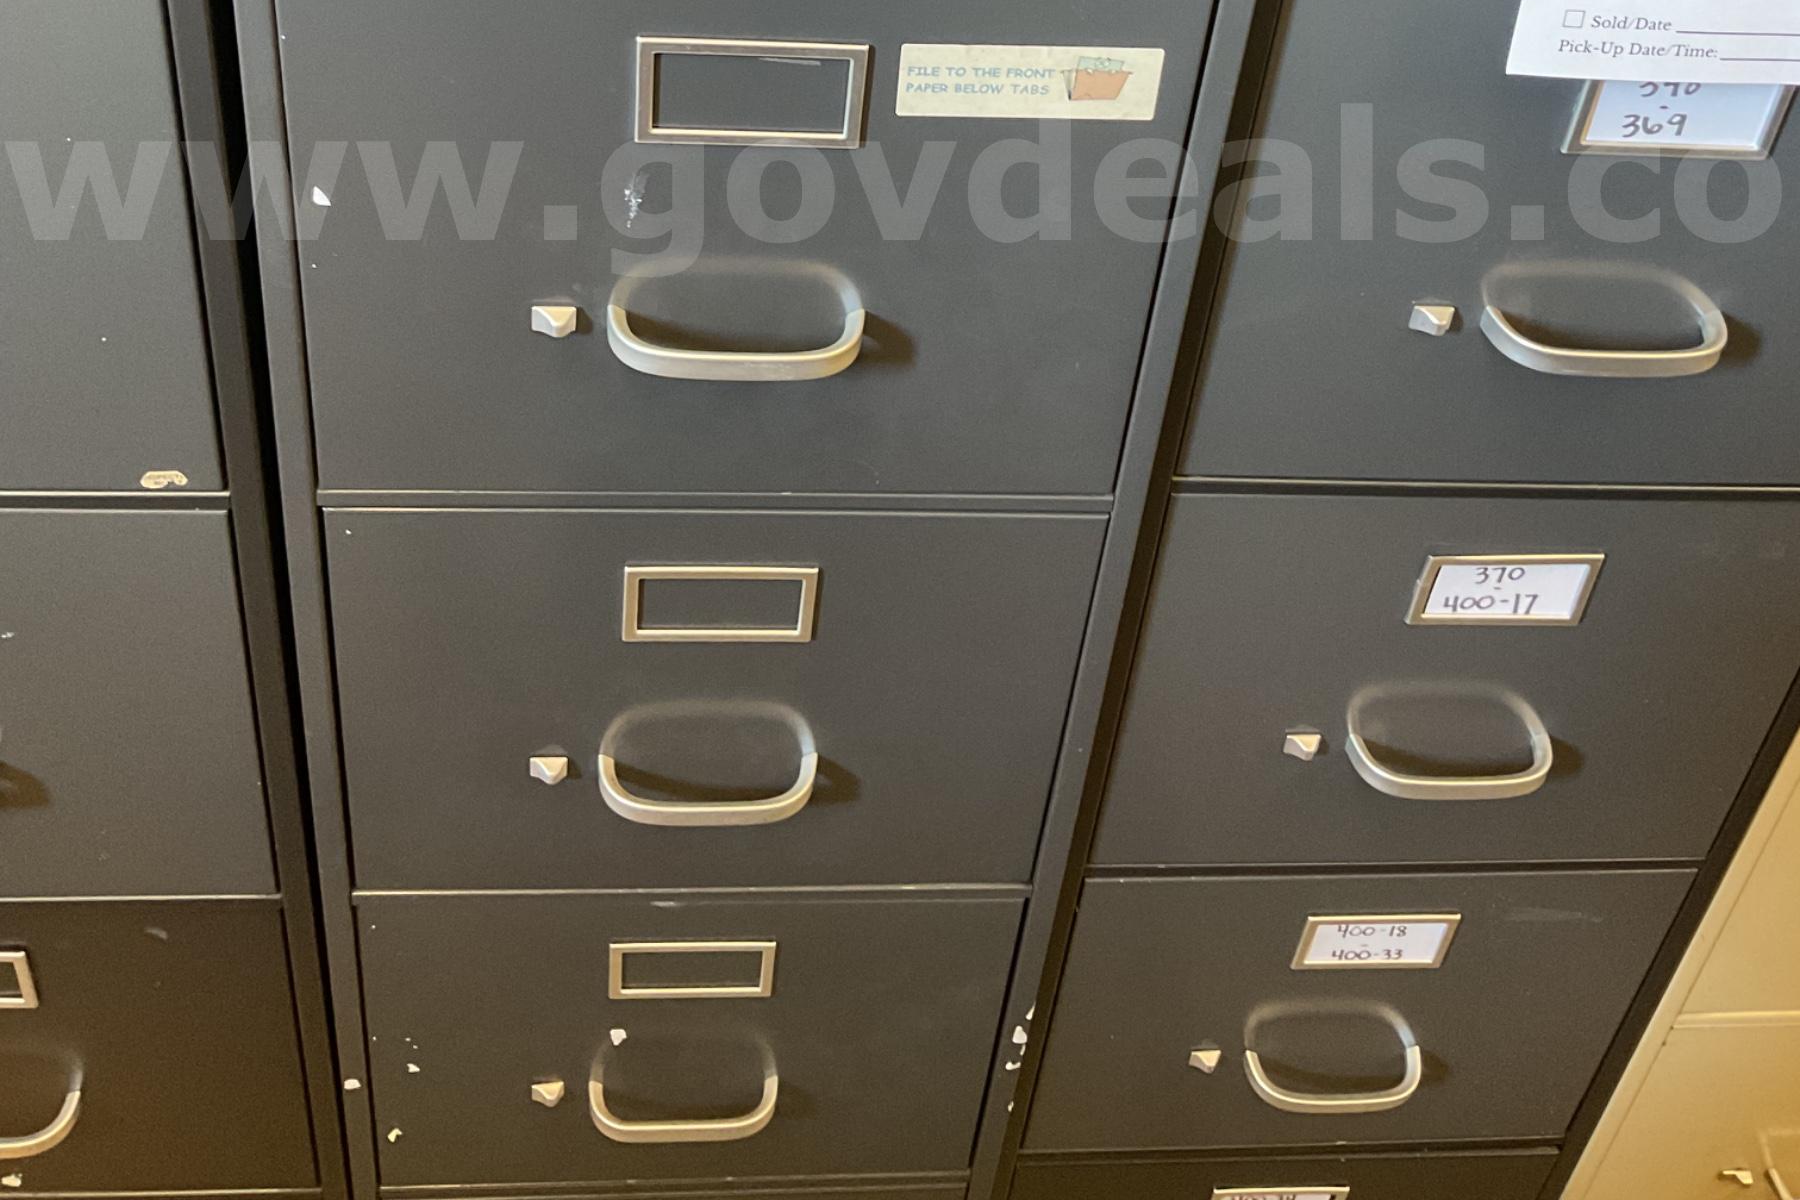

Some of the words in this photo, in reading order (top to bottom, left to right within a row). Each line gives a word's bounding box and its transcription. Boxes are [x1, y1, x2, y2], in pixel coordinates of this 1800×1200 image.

[1591, 15, 1672, 31] Sold/Date
[1558, 39, 1624, 58] Pick-Up
[1628, 42, 1718, 58] Date/Time:
[906, 66, 940, 77] FILE
[946, 66, 966, 77] TO
[972, 67, 1001, 78] THE
[1006, 68, 1056, 80] FRONT
[905, 83, 948, 94] PAPER
[954, 83, 1004, 95] BELOW
[1009, 84, 1050, 95] TABS
[1622, 113, 1688, 138] 369
[1474, 566, 1526, 585] 370
[1443, 593, 1539, 615] 400-17
[1337, 924, 1408, 939] 400-18
[1331, 949, 1404, 961] 400-33
